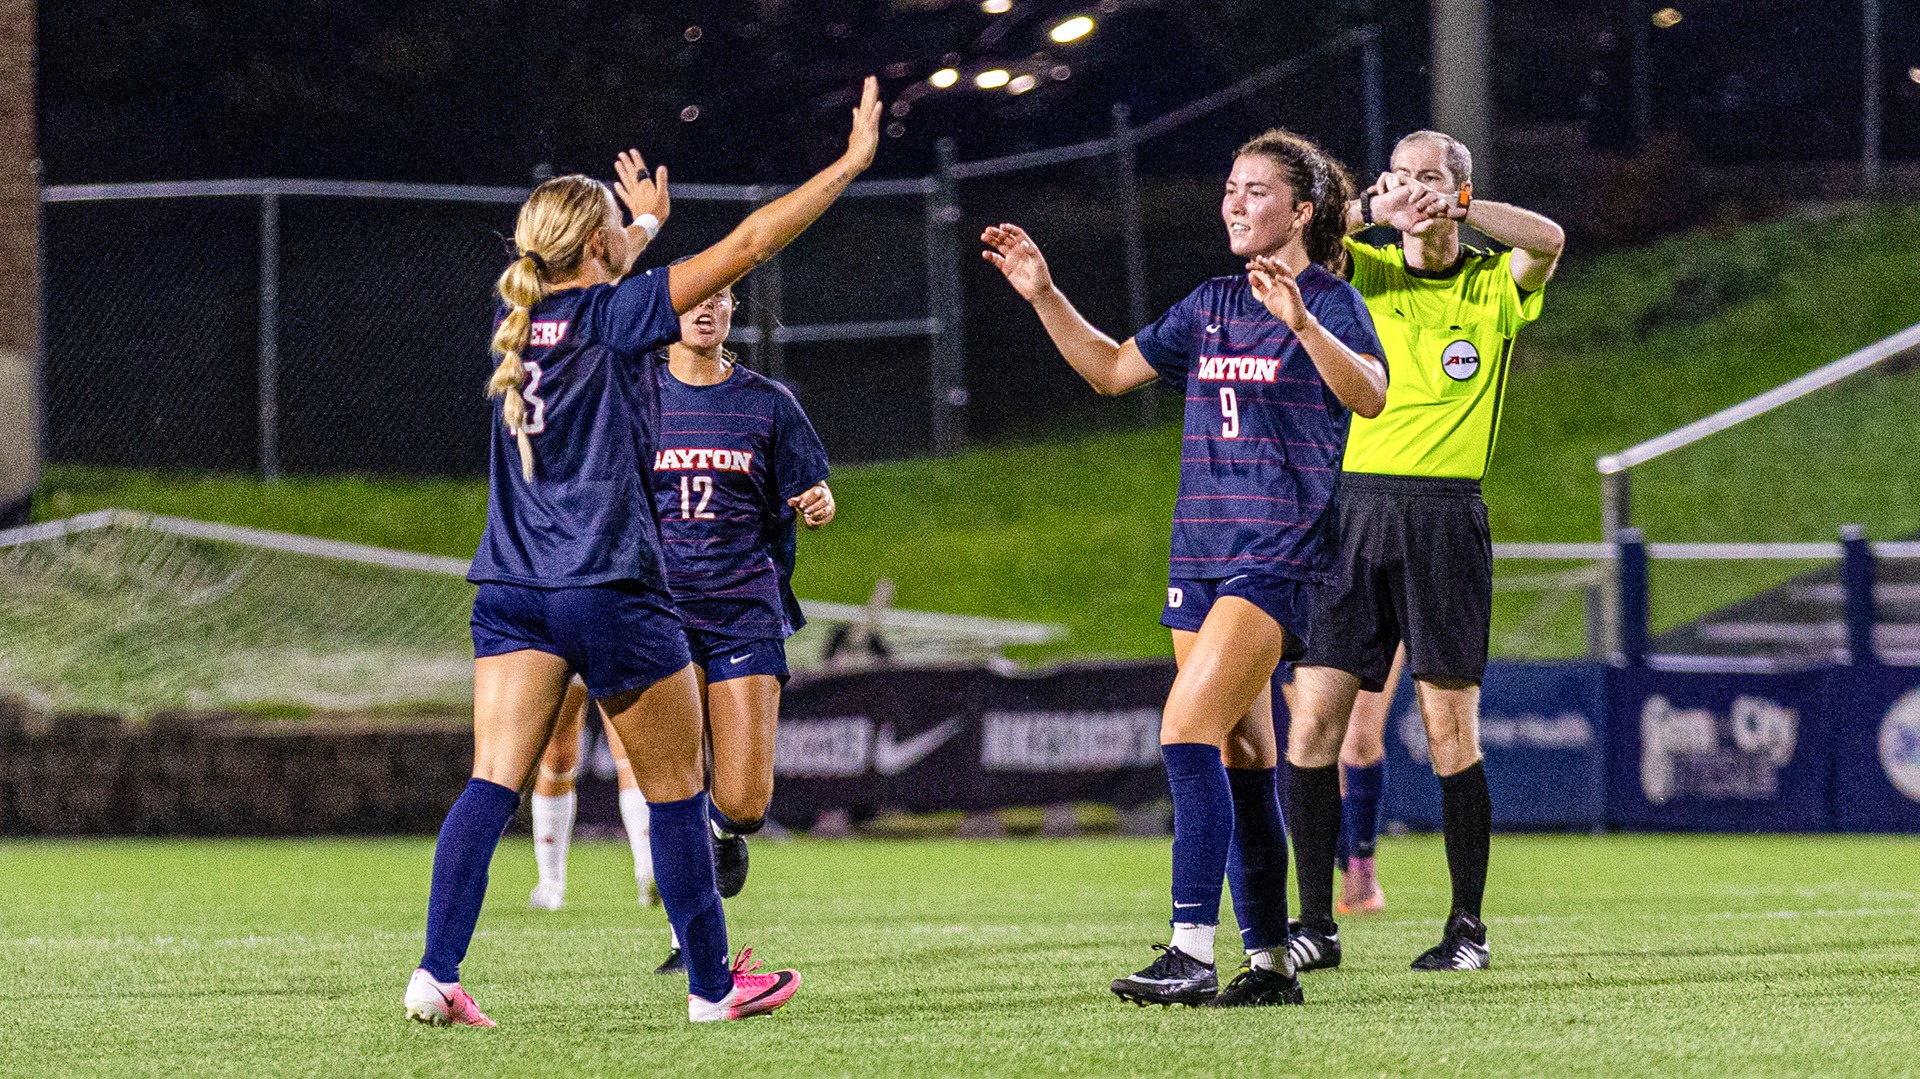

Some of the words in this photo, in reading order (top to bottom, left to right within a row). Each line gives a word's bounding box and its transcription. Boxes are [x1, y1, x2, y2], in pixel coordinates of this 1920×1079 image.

[1444, 355, 1478, 366] A10
[1219, 387, 1240, 440] 9
[681, 475, 716, 520] 12
